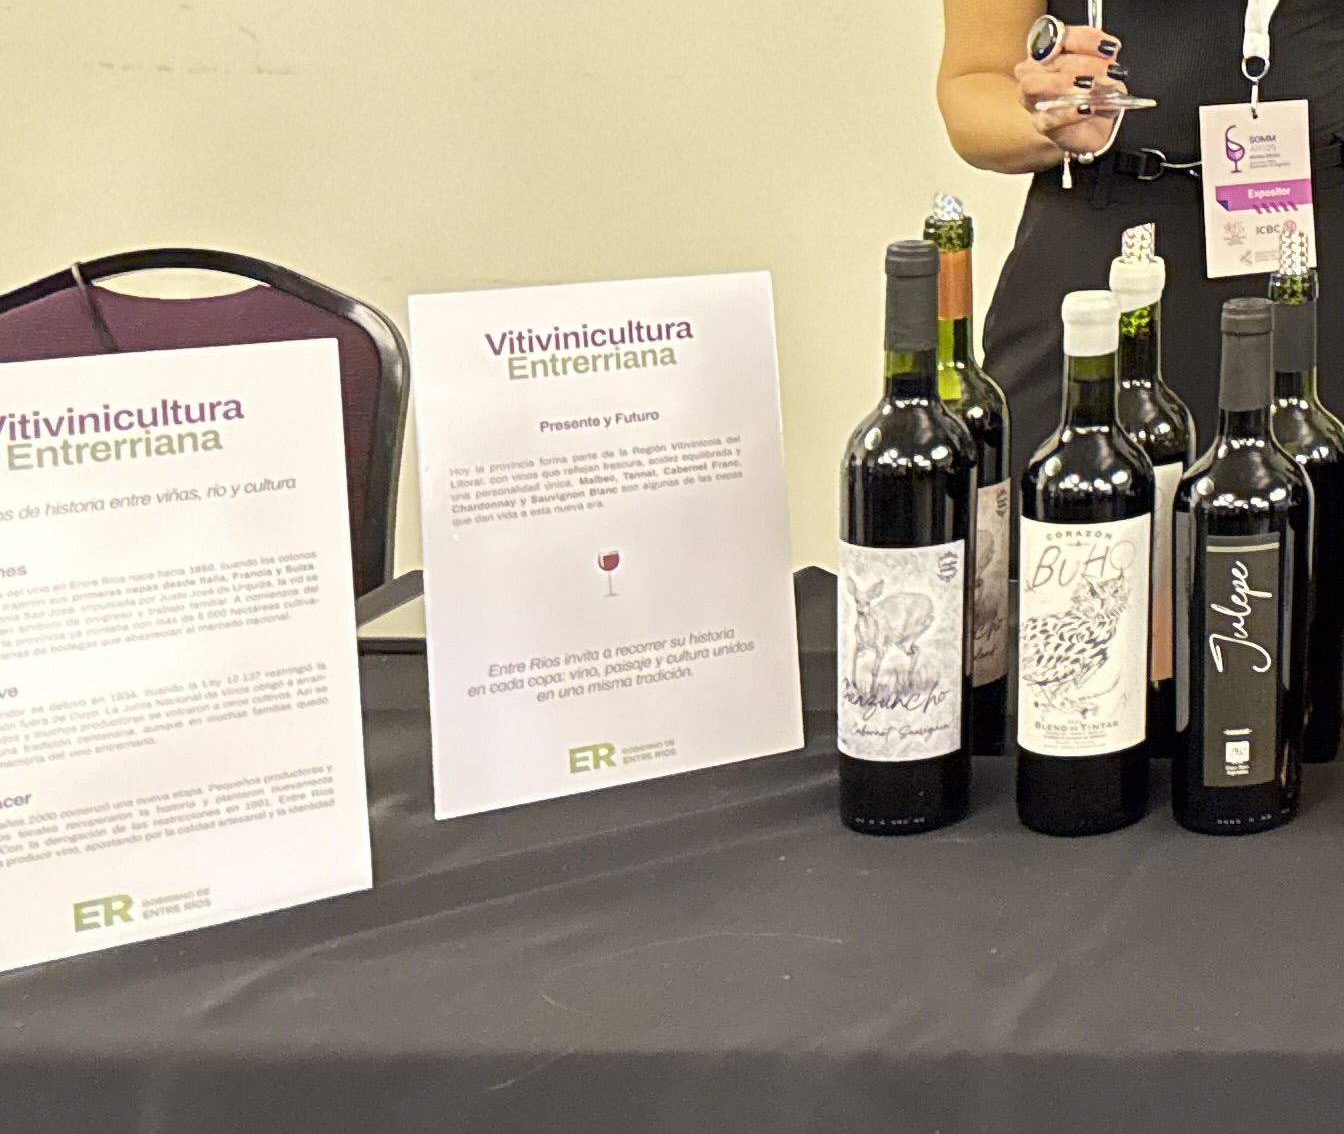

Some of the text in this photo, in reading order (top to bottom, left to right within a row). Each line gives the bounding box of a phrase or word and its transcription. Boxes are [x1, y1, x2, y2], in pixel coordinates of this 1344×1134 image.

[1248, 187, 1291, 199] Expositor
[1256, 224, 1281, 234] ICBC
[485, 321, 693, 356] Vitivinicultura
[507, 346, 677, 380] Entrerriana
[540, 411, 659, 433] Presente y Futuro
[7, 429, 223, 470] Entrerriana
[19, 505, 40, 520] de
[45, 499, 104, 516] historia
[110, 493, 151, 510] entre
[156, 487, 201, 504] viñas,
[231, 484, 240, 498] y
[244, 476, 296, 493] cultura
[452, 498, 516, 514] Chardonnay
[531, 490, 585, 505] Sauvignon
[1209, 560, 1273, 673] Julepe
[468, 685, 486, 698] en
[490, 678, 524, 694] cada
[604, 658, 652, 678] paisaje
[655, 656, 663, 668] y
[666, 648, 709, 665] cultura
[713, 639, 754, 657] unidos
[488, 662, 526, 678] Entre
[564, 648, 600, 665] invita
[603, 648, 612, 658] a
[616, 639, 666, 658] recorrer
[670, 636, 686, 648] su
[689, 627, 734, 645] historia
[536, 667, 694, 702] en una misma tradición.
[568, 742, 616, 774] ER
[73, 894, 134, 932] ER
[143, 904, 180, 920] ENTRE
